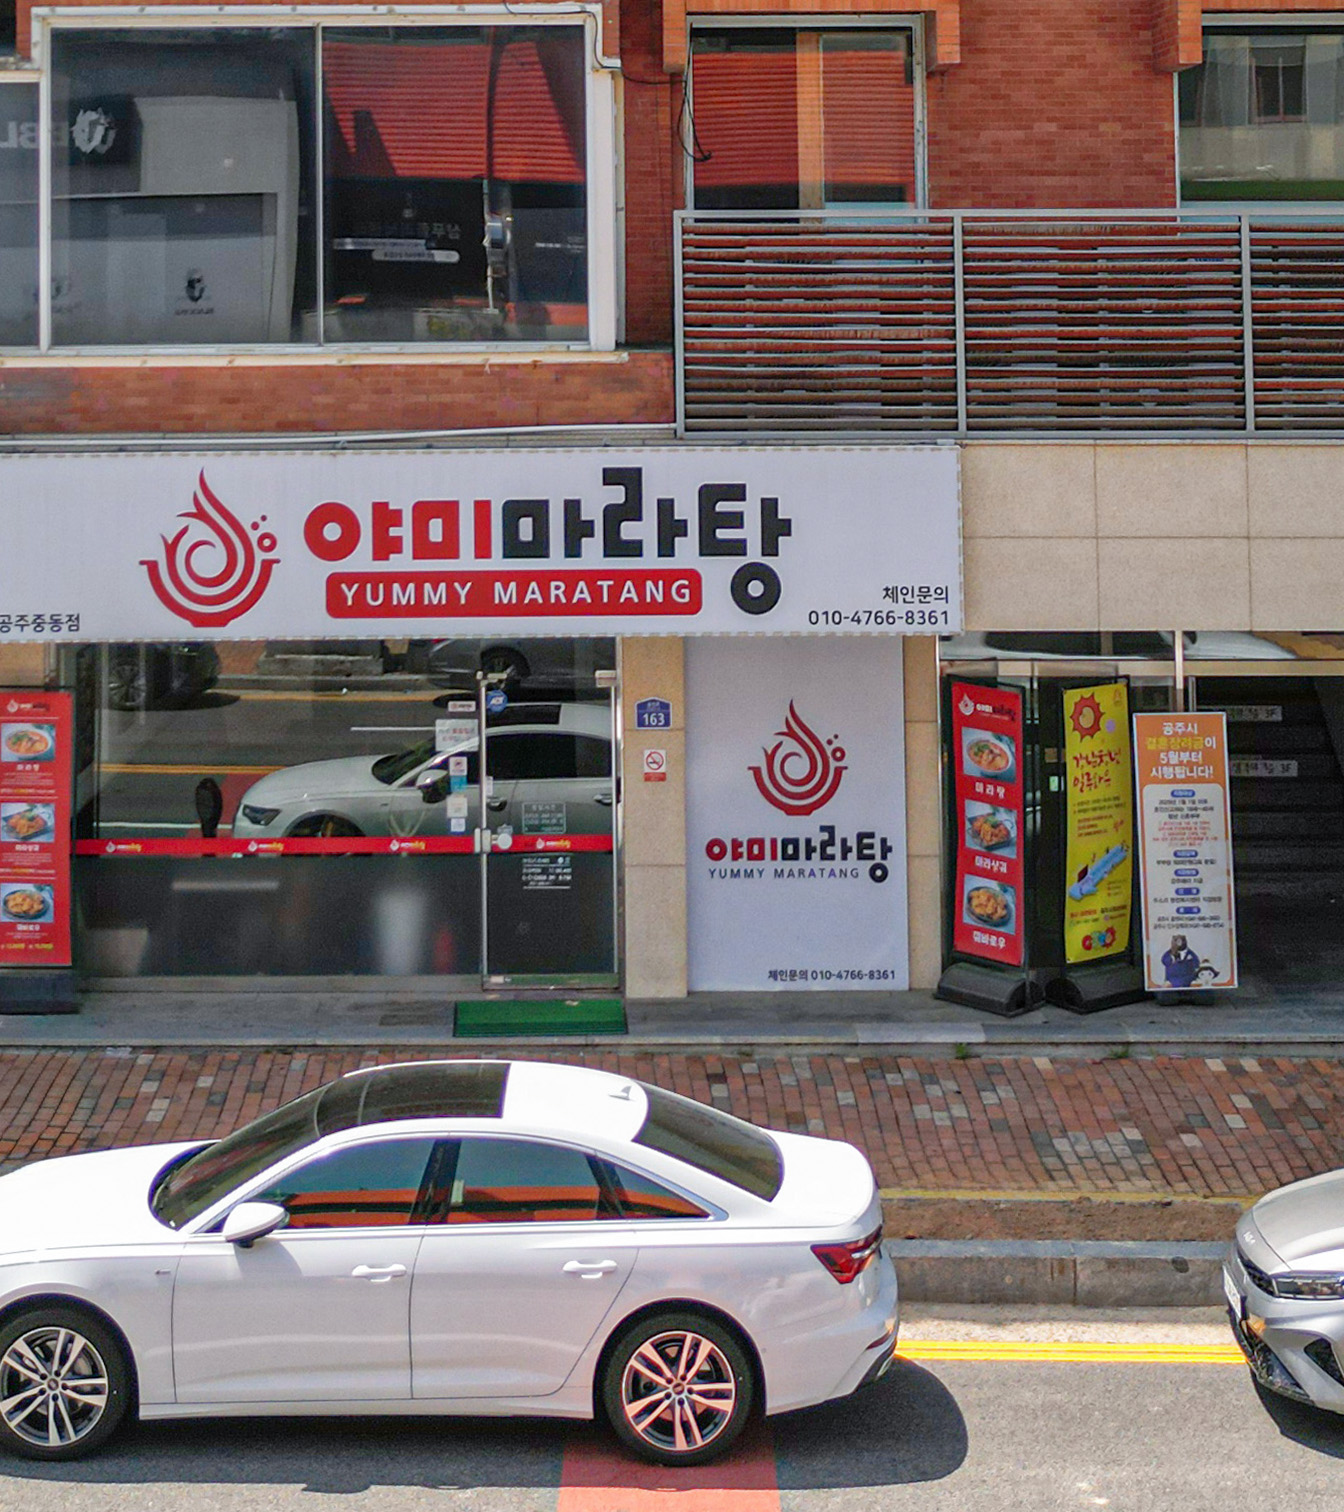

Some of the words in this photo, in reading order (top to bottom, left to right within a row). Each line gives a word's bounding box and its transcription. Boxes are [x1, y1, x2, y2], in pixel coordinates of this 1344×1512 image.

[304, 466, 792, 615] 야미마라탕
[341, 581, 473, 606] YUMMY
[494, 579, 692, 605] MARATANG
[882, 585, 950, 605] 체인문의
[809, 608, 950, 627] 010-4766-8361
[642, 712, 665, 726] 163
[1162, 722, 1198, 735] 공주시
[1159, 751, 1203, 765] 5월부터
[1150, 765, 1214, 779] 시행됩니다!
[706, 825, 893, 883] 야미마라탕
[708, 868, 766, 879] YUMMY
[773, 867, 860, 879] MARATANG
[768, 969, 808, 981] 체인문의
[810, 969, 896, 981] 010-4766-8361
